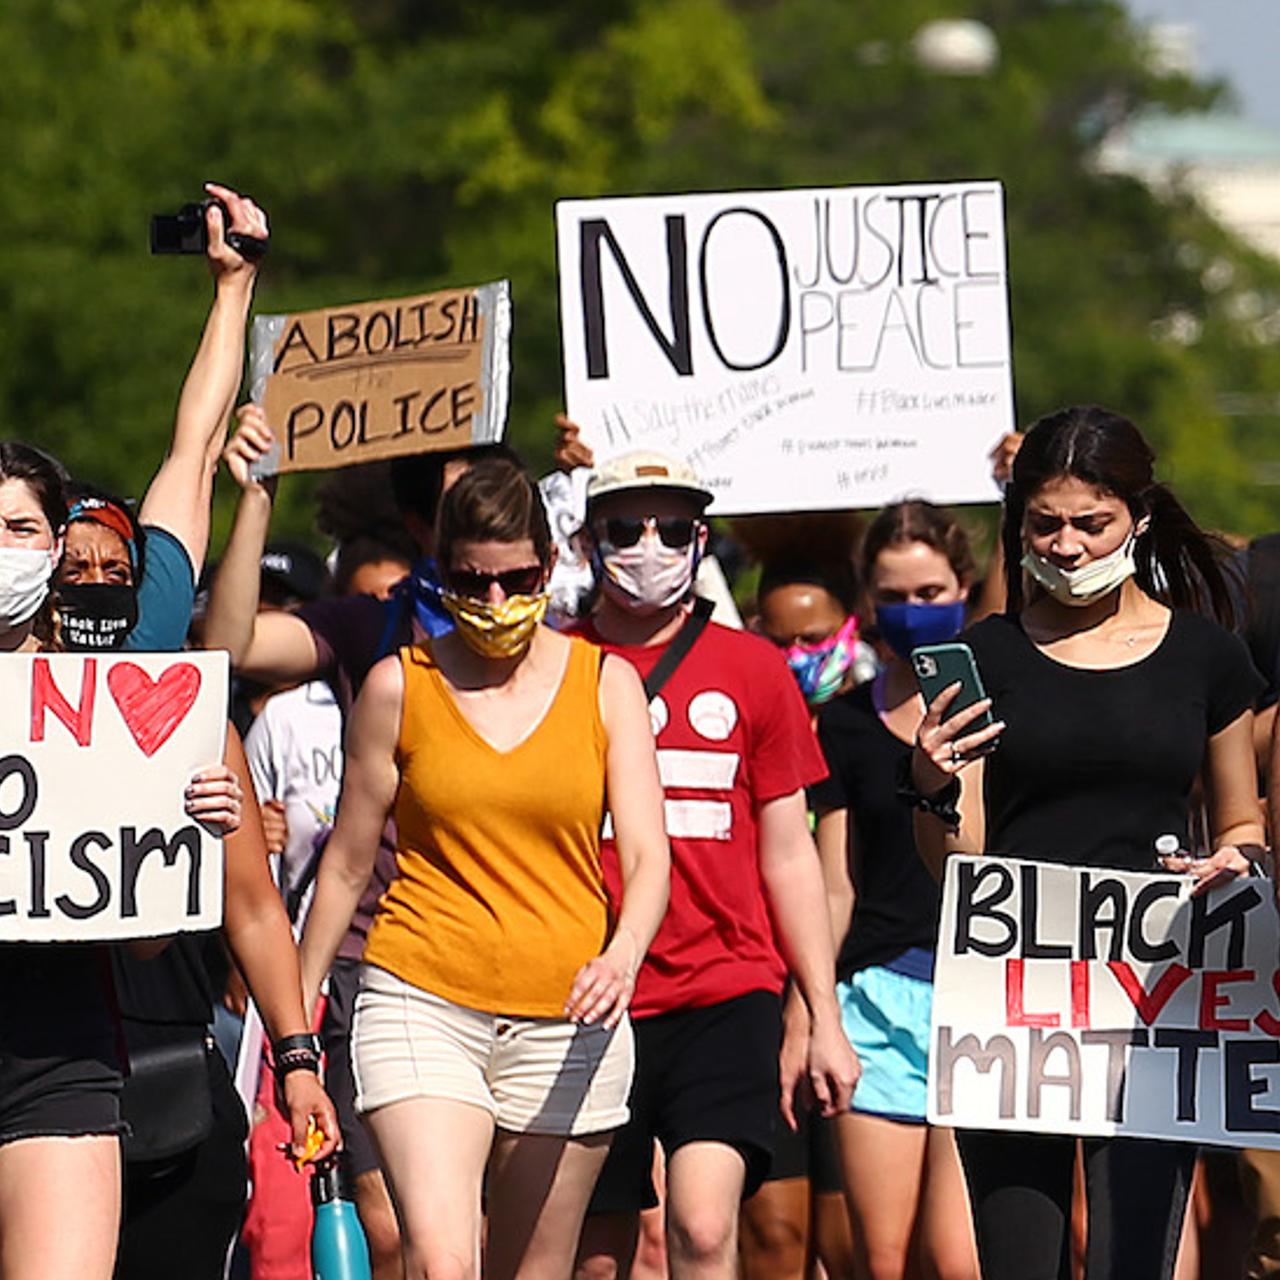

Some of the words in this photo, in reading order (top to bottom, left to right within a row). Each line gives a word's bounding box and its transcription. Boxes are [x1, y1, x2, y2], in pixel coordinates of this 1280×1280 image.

[579, 207, 791, 379] NO
[795, 190, 1001, 288] JUSTICE
[801, 281, 1005, 373] PEACE
[273, 295, 479, 373] ABOLISH
[288, 383, 475, 461] POLICE
[954, 862, 1262, 969] BLACK
